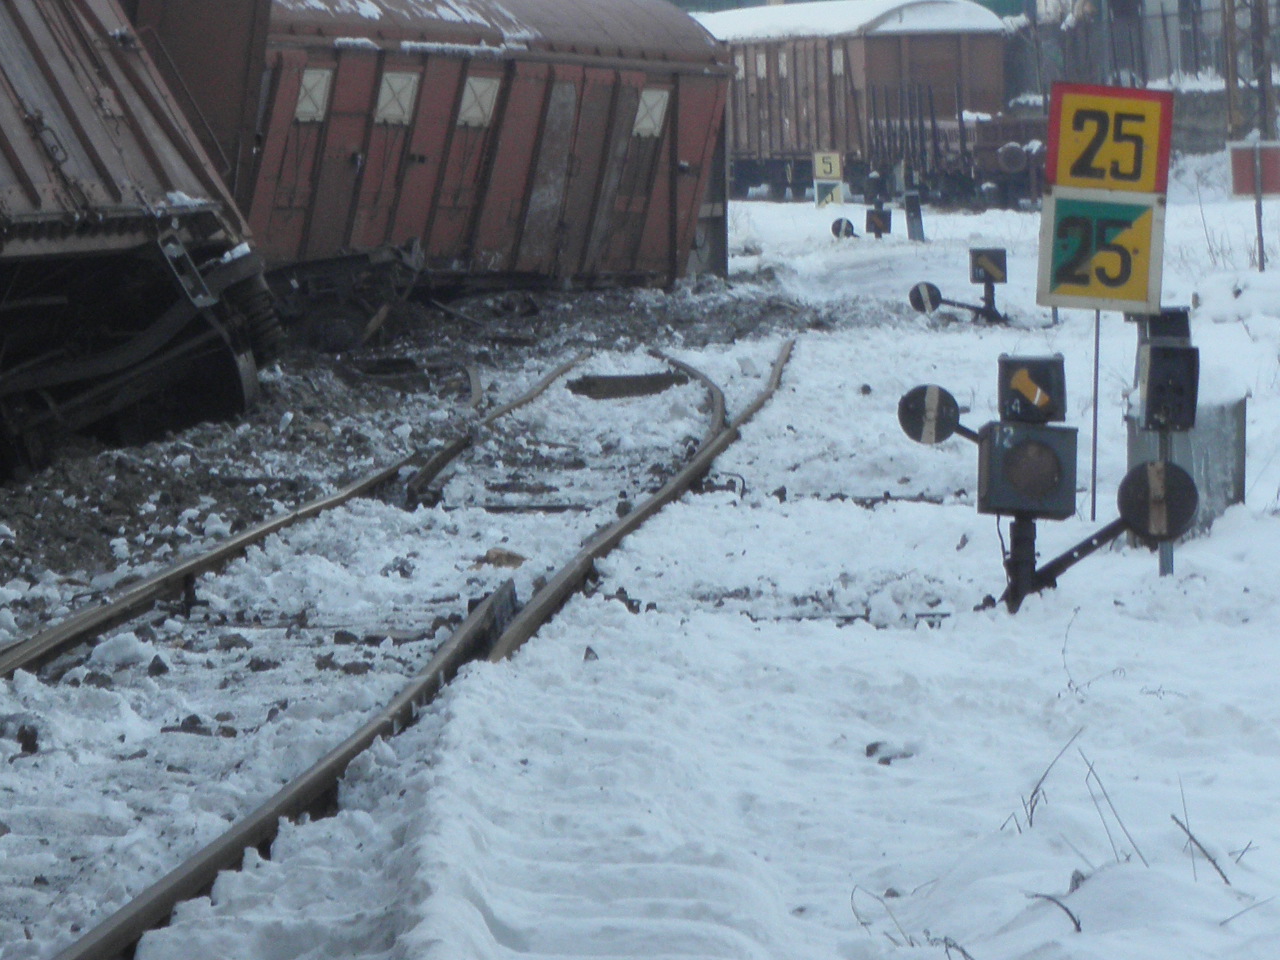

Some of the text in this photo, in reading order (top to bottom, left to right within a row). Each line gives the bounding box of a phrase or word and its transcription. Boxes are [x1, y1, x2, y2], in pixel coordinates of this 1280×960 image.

[822, 155, 833, 175] 5
[1070, 108, 1146, 183] 25
[1054, 215, 1133, 288] 25
